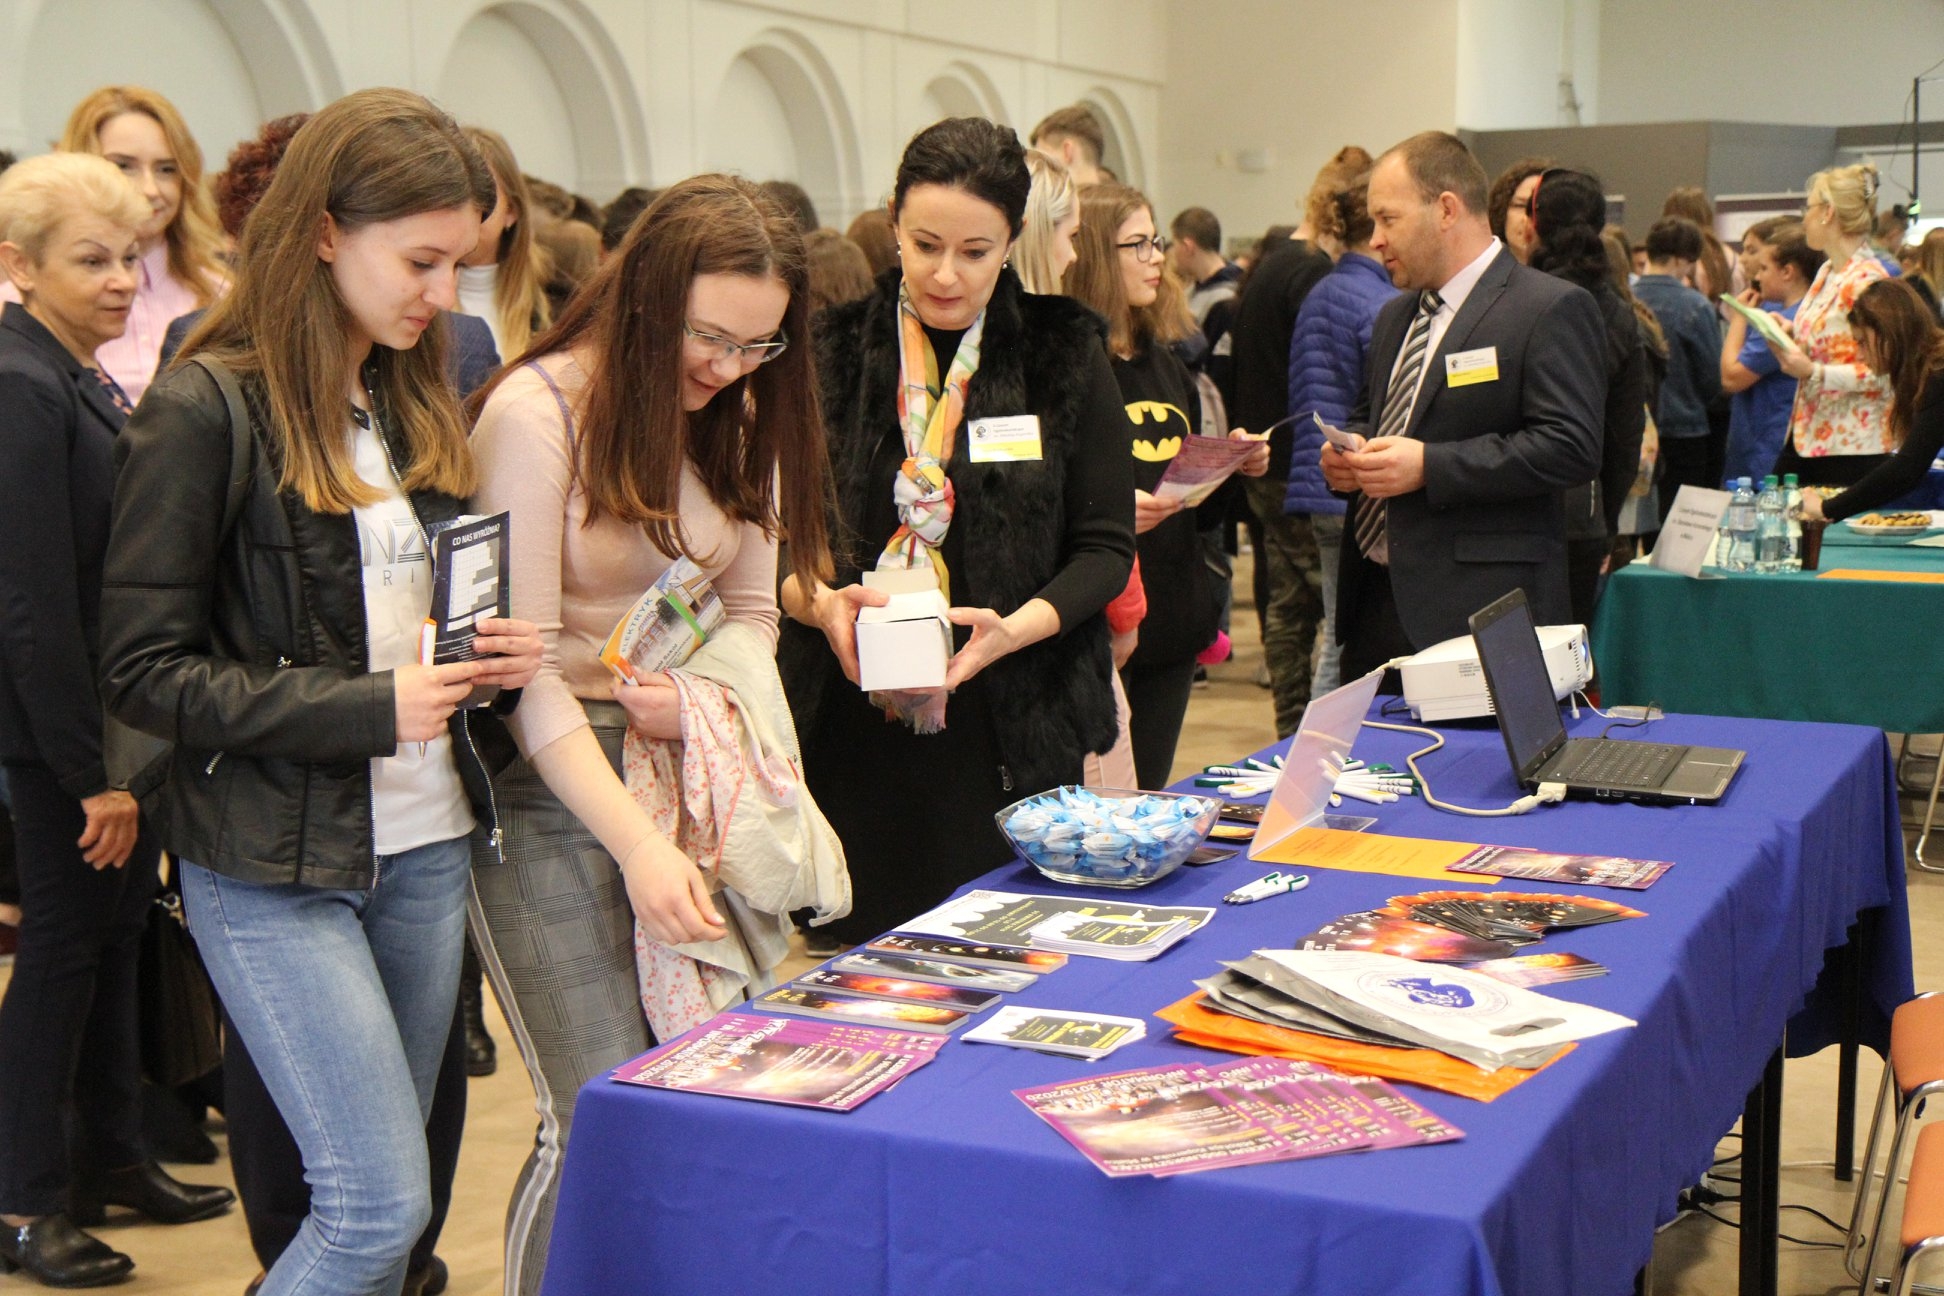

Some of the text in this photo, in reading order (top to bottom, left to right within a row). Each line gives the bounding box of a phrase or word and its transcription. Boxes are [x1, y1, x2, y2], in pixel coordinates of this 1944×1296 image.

[452, 537, 462, 546] CO
[462, 533, 473, 544] NAS
[1099, 1069, 1187, 1088] INFORMATOR
[1025, 1083, 1099, 1101] 2019/2020
